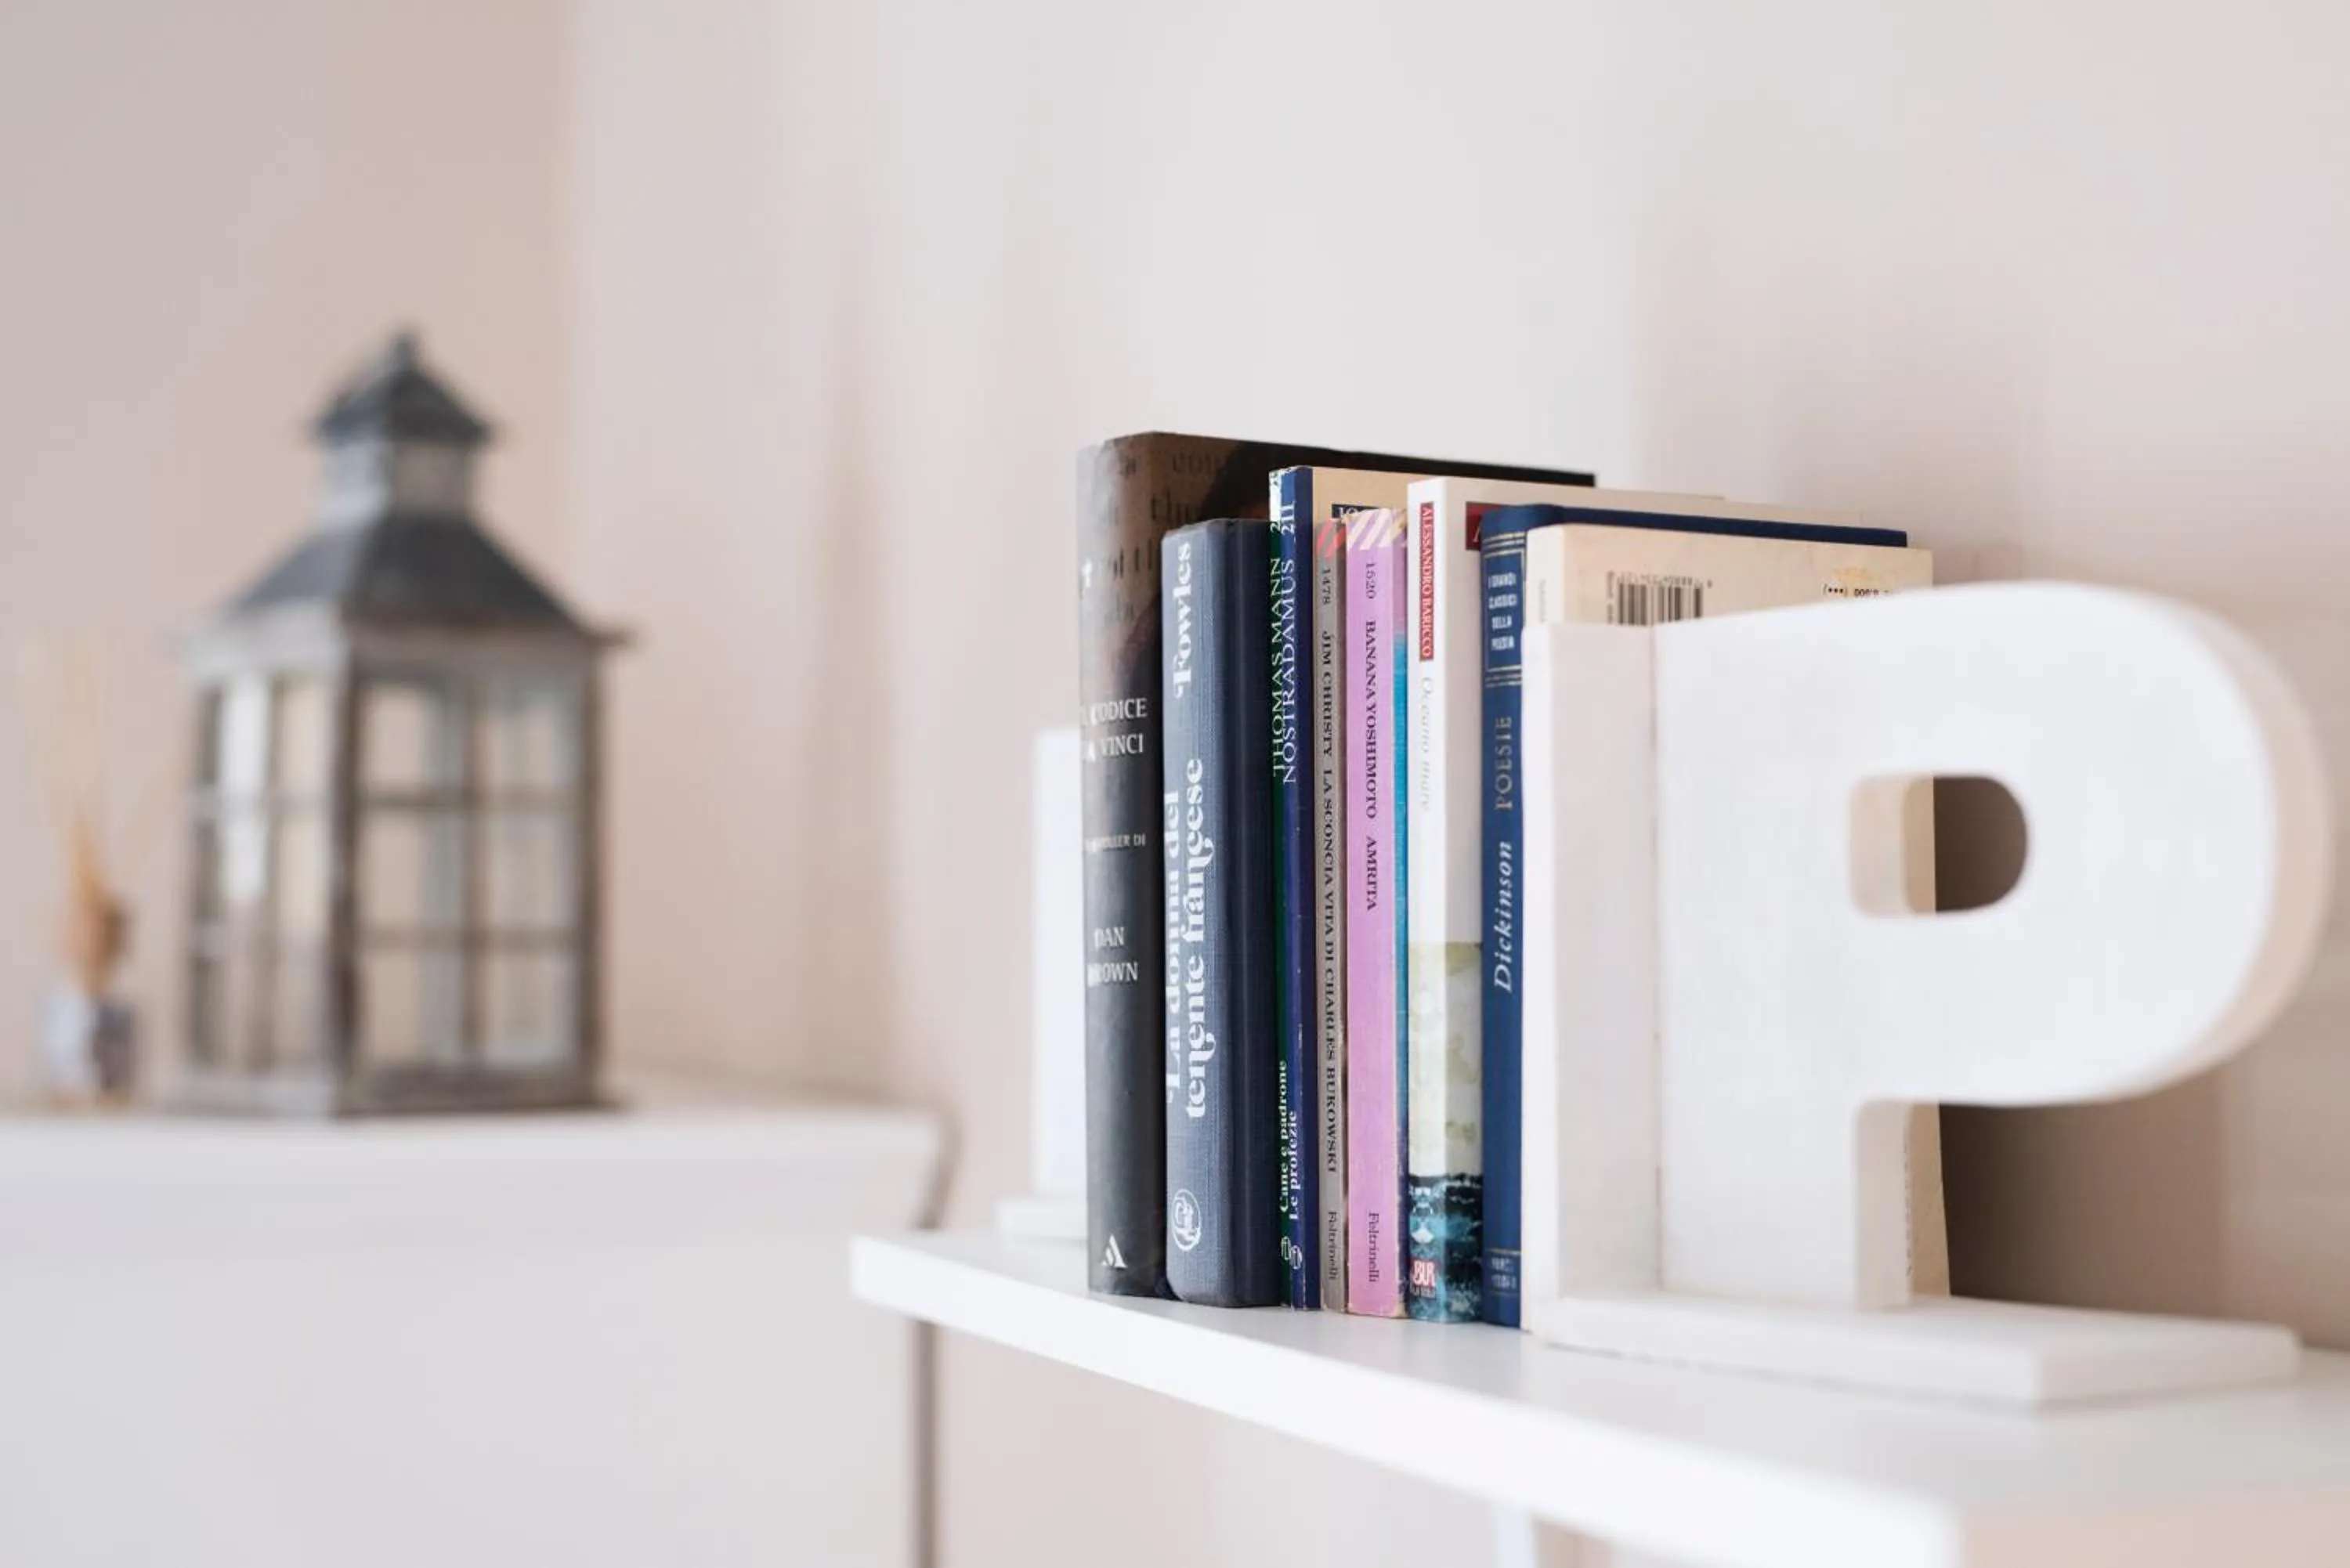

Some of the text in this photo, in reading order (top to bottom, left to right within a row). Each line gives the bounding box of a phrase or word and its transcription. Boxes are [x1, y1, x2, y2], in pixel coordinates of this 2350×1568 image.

[1172, 542, 1191, 699] Fowles
[1271, 557, 1282, 643] MANN
[1421, 507, 1433, 657] ALESSANDRO BARICCO
[1281, 559, 1297, 784] NOSTRADAMUS
[1321, 630, 1332, 665] JIM
[1090, 697, 1148, 727] CODICE
[1101, 733, 1144, 757] VINCI
[1271, 652, 1284, 776] THOMAS
[1322, 671, 1333, 757] CHRISTY
[1365, 562, 1378, 911] 1520 BANANA YOSHIMOTO AMRITA
[1323, 769, 1333, 793] LA
[1495, 715, 1513, 810] POESIE
[1163, 790, 1180, 858] del
[1323, 798, 1334, 886] SCONCIA
[1094, 927, 1125, 951] DAN
[1180, 758, 1217, 1118] tenente francese
[1324, 890, 1335, 936] VITA
[1325, 941, 1335, 961] DI
[1493, 841, 1513, 993] Dickinson
[1325, 968, 1336, 1060] CHARLES
[1278, 1060, 1289, 1212] Cane e padrone
[1325, 1067, 1337, 1173] BUKOWSKI
[1287, 1111, 1301, 1220] Le profezie
[1328, 1212, 1338, 1280] Feltrinelli
[1368, 1212, 1379, 1282] Feltrinelli
